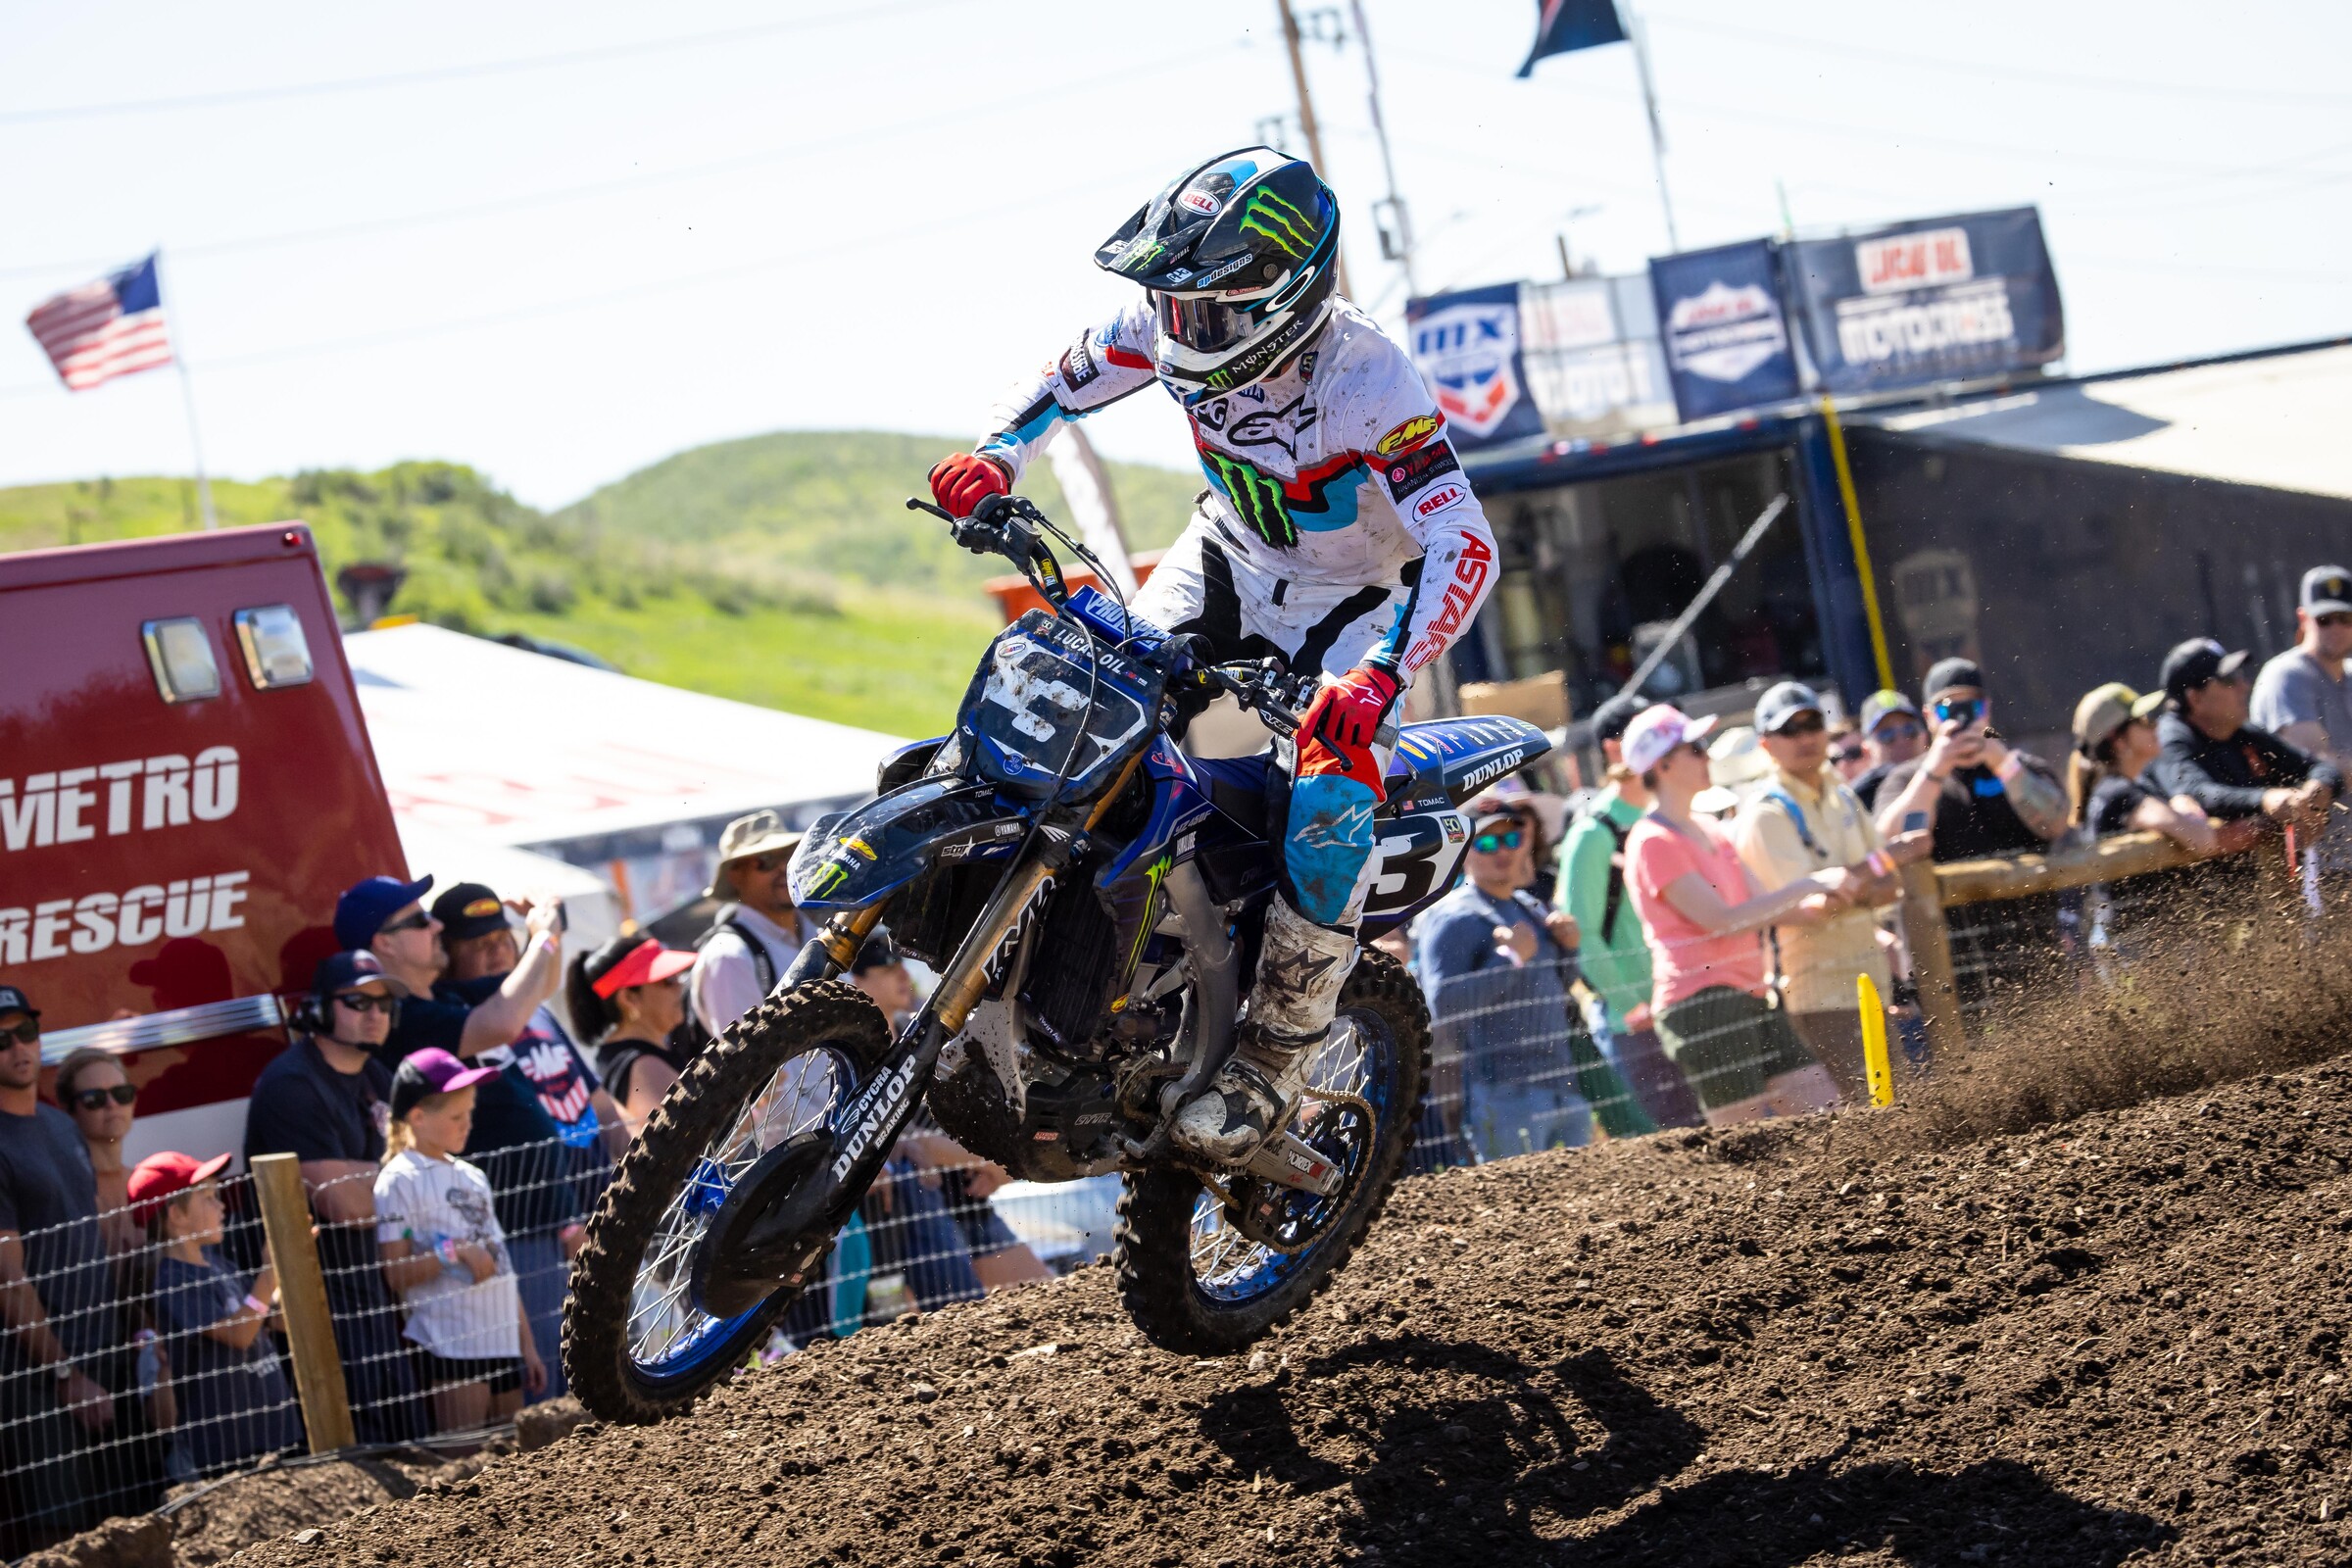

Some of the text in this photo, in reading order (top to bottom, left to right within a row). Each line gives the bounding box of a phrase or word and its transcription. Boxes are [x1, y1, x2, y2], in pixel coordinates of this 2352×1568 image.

[1183, 193, 1214, 213] BELL
[1175, 245, 1190, 262] TOMAC
[1167, 268, 1192, 283] PPG
[1197, 253, 1252, 288] apdesigns
[1231, 319, 1304, 374] MONSTER
[1377, 417, 1436, 456] FMF
[1418, 488, 1463, 515] BELL
[1054, 628, 1103, 659] LUCAS
[1099, 653, 1125, 675] OIL
[1462, 749, 1525, 792] DUNLOP
[0, 745, 240, 852] METRO
[974, 787, 995, 799] TOMAC
[1417, 797, 1446, 808] TOMAC
[1000, 821, 1020, 836] YAMAHA
[1444, 817, 1461, 834] 50
[1362, 815, 1443, 913] 3
[0, 869, 250, 968] RESCUE
[1039, 1016, 1054, 1034] Twin
[858, 1065, 893, 1112] CYCRA
[831, 1054, 916, 1183] DUNLOP
[874, 1098, 911, 1150] BRAKING
[1075, 1112, 1112, 1126] GYTR
[1285, 1149, 1315, 1174] VORTEX
